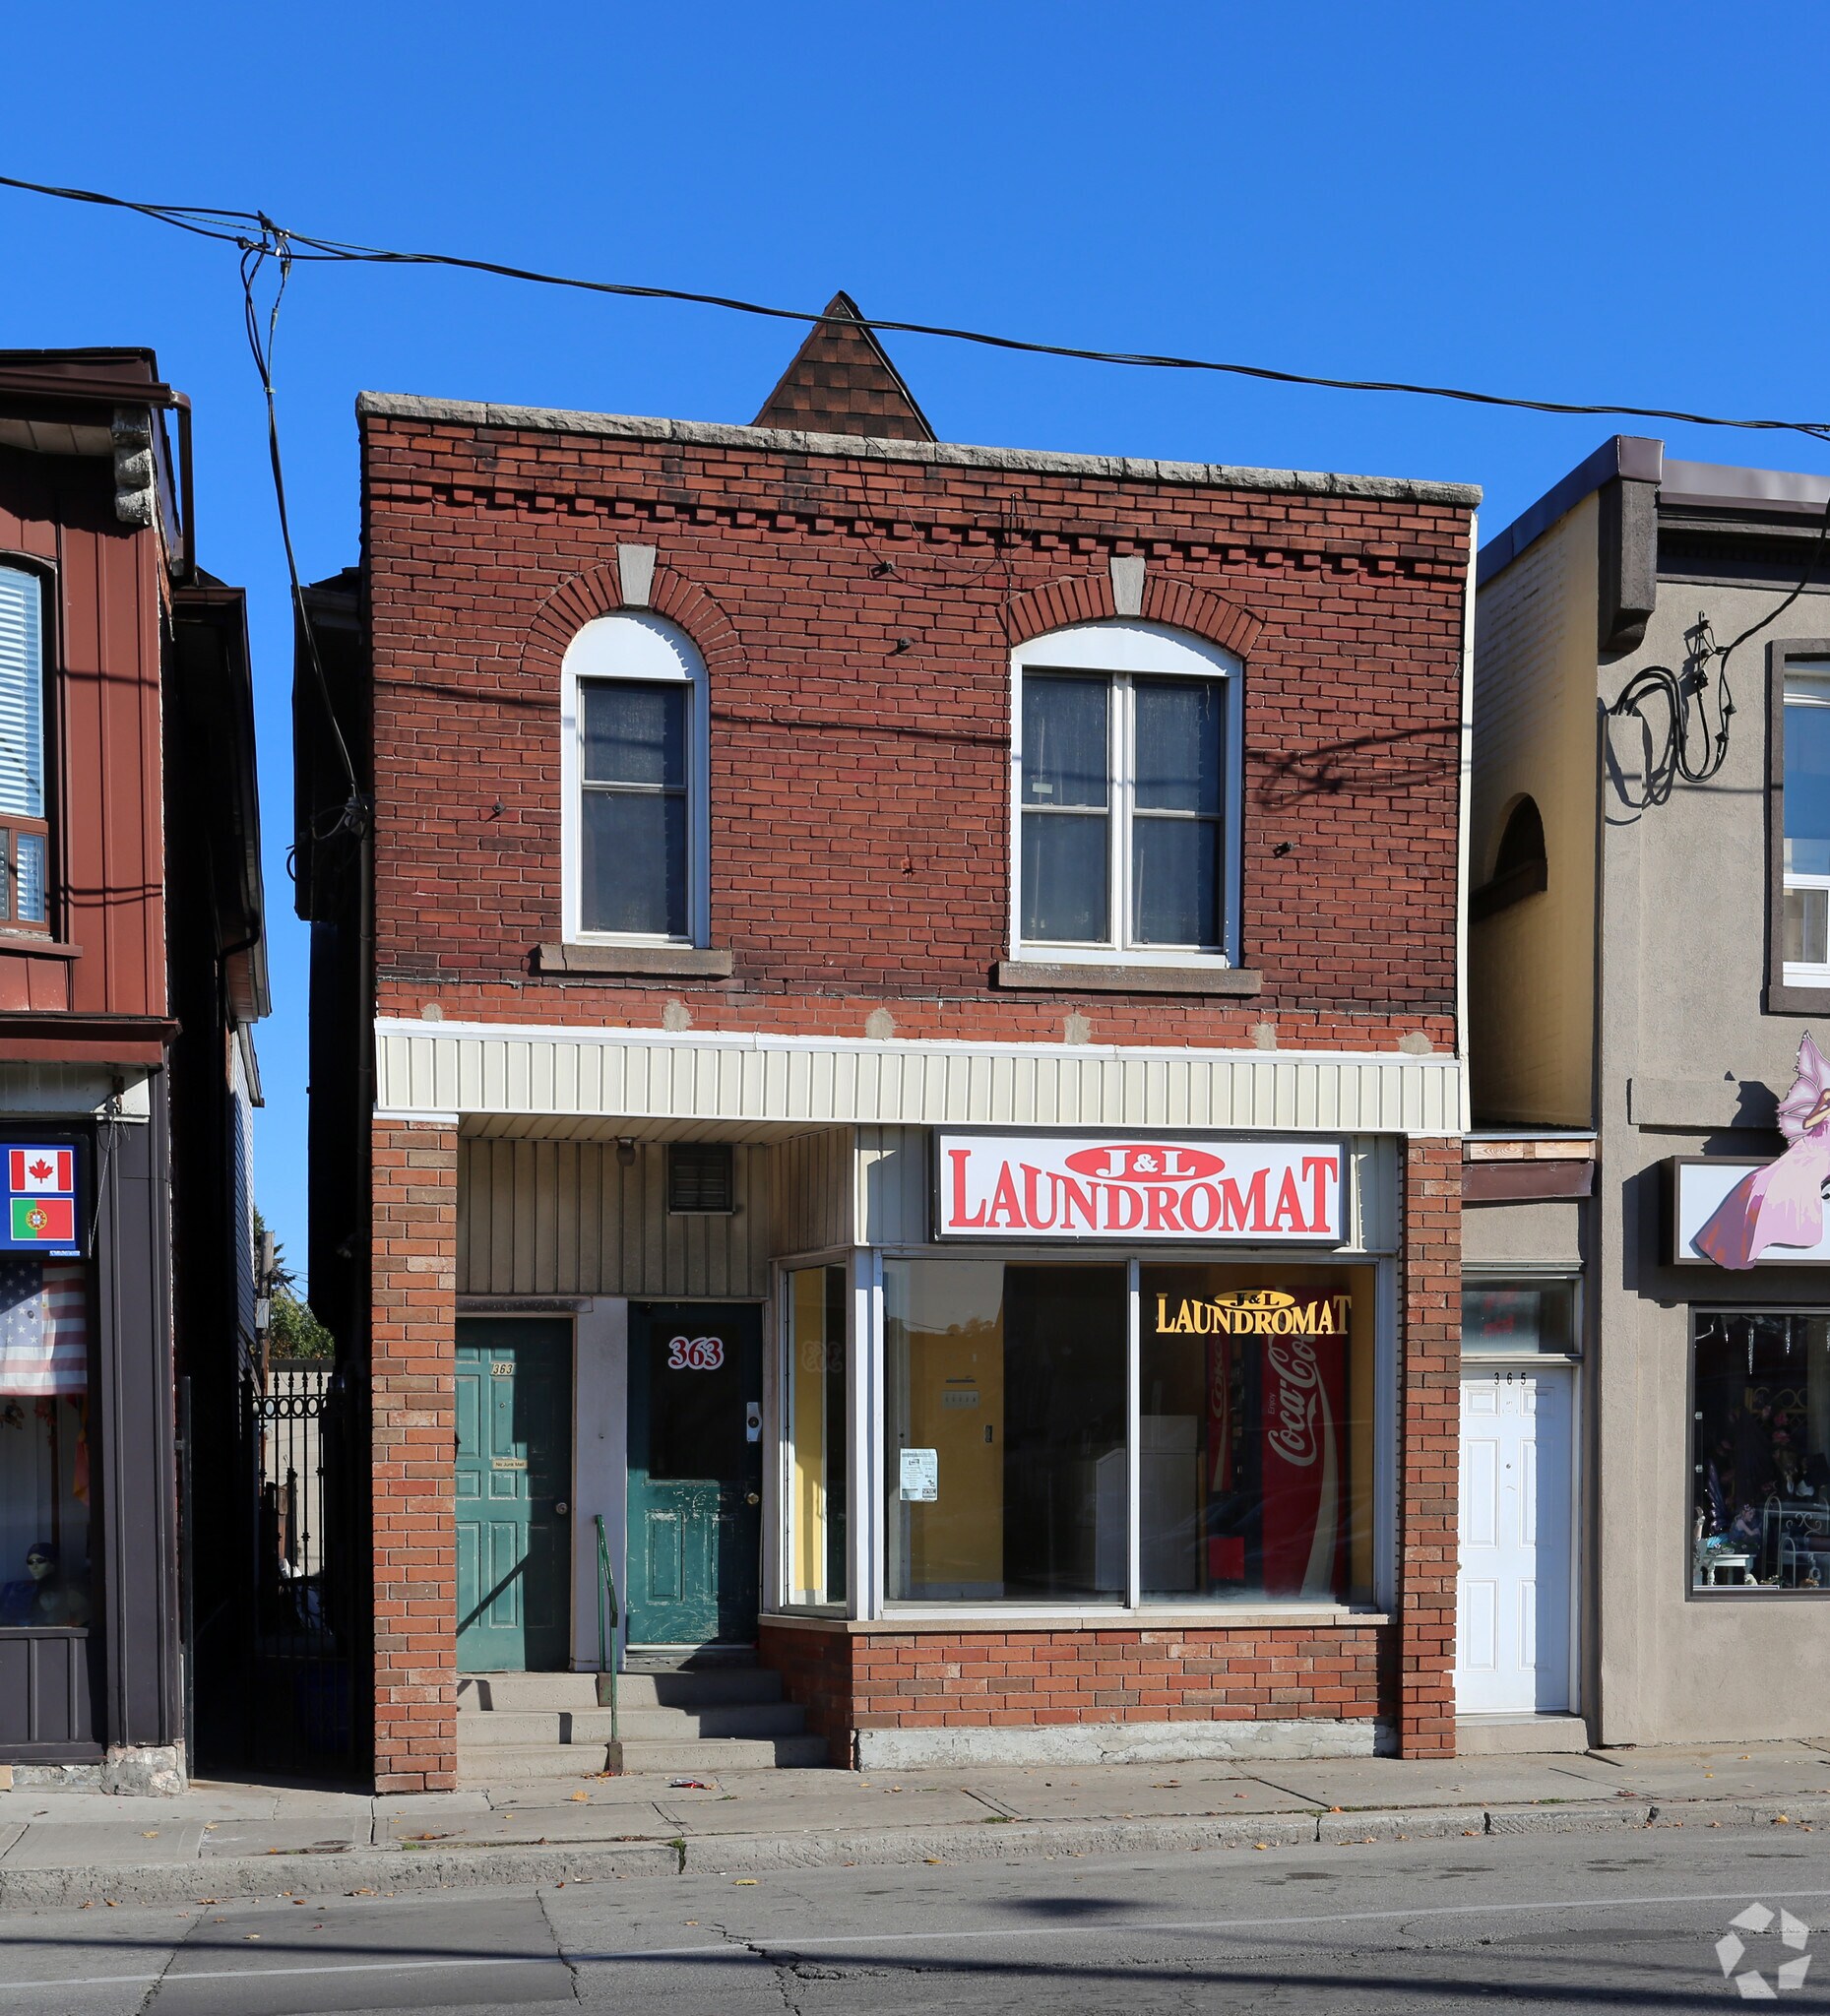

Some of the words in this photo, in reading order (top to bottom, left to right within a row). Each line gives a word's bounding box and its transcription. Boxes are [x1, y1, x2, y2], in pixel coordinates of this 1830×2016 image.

[1096, 1149, 1196, 1178] J&L
[948, 1149, 1338, 1232] LAUNDROMAT
[1230, 1292, 1280, 1306] J&L
[1156, 1292, 1352, 1335] LAUNDROMAT
[667, 1336, 725, 1370] 363
[493, 1363, 513, 1374] 363
[1493, 1371, 1527, 1385] 365
[1267, 1392, 1277, 1415] Enjoy
